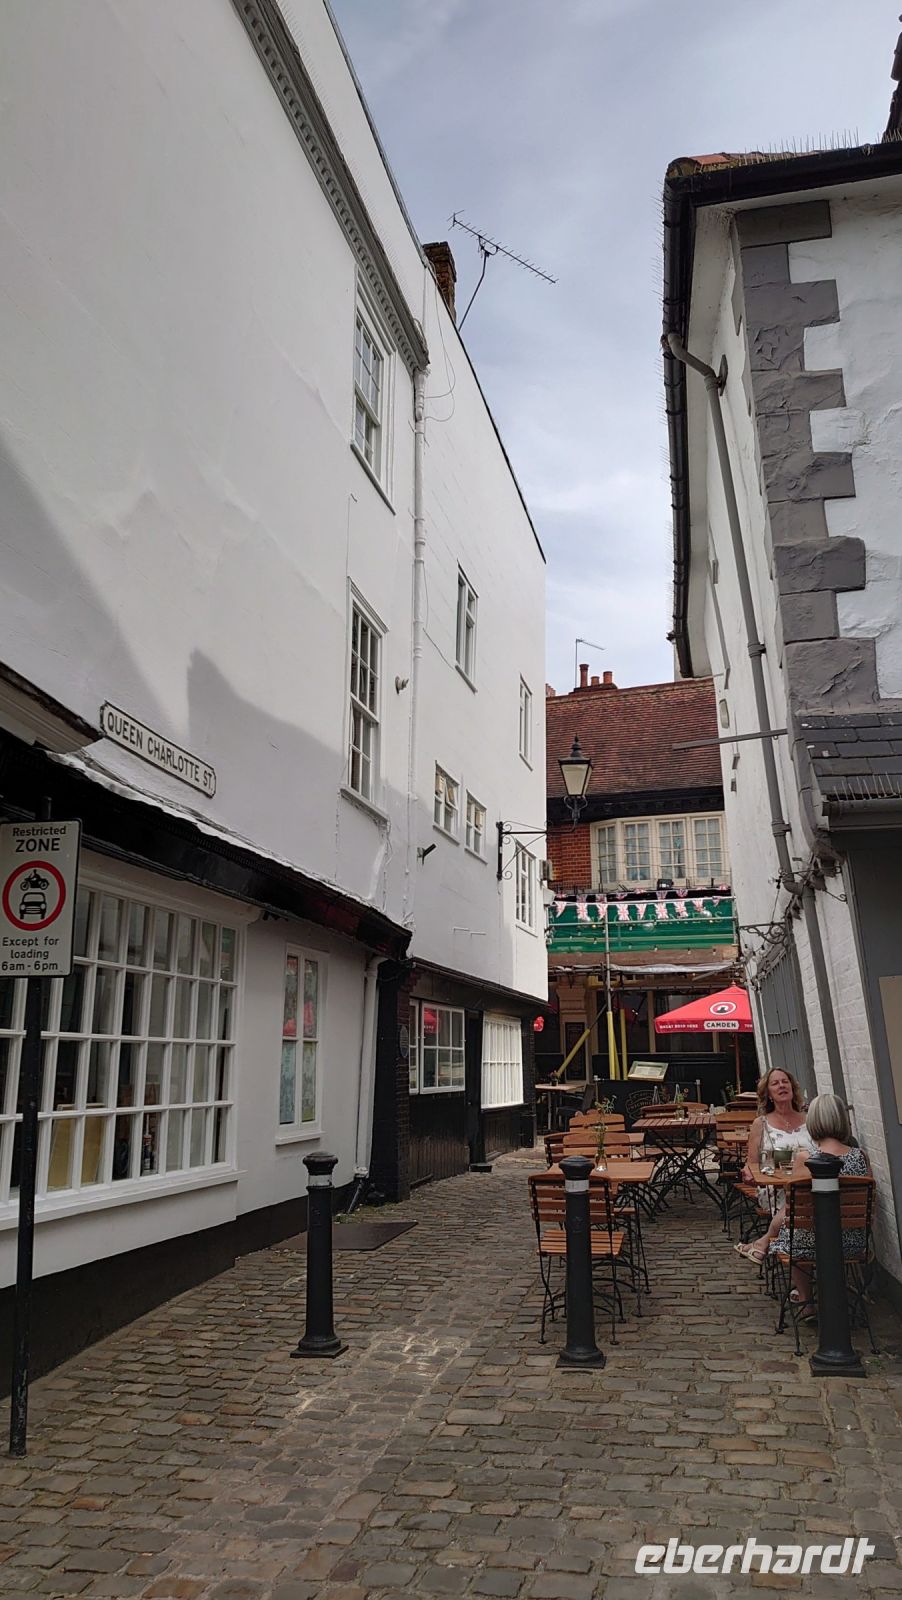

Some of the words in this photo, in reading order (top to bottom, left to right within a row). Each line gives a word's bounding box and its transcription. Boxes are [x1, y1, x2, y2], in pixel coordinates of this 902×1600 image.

[107, 711, 143, 749] QUEEN
[147, 737, 200, 782] CHARLOTTE
[12, 826, 67, 837] Restricted
[15, 838, 61, 853] ZONE
[2, 937, 39, 948] Except
[44, 936, 59, 946] for
[10, 949, 49, 960] loading
